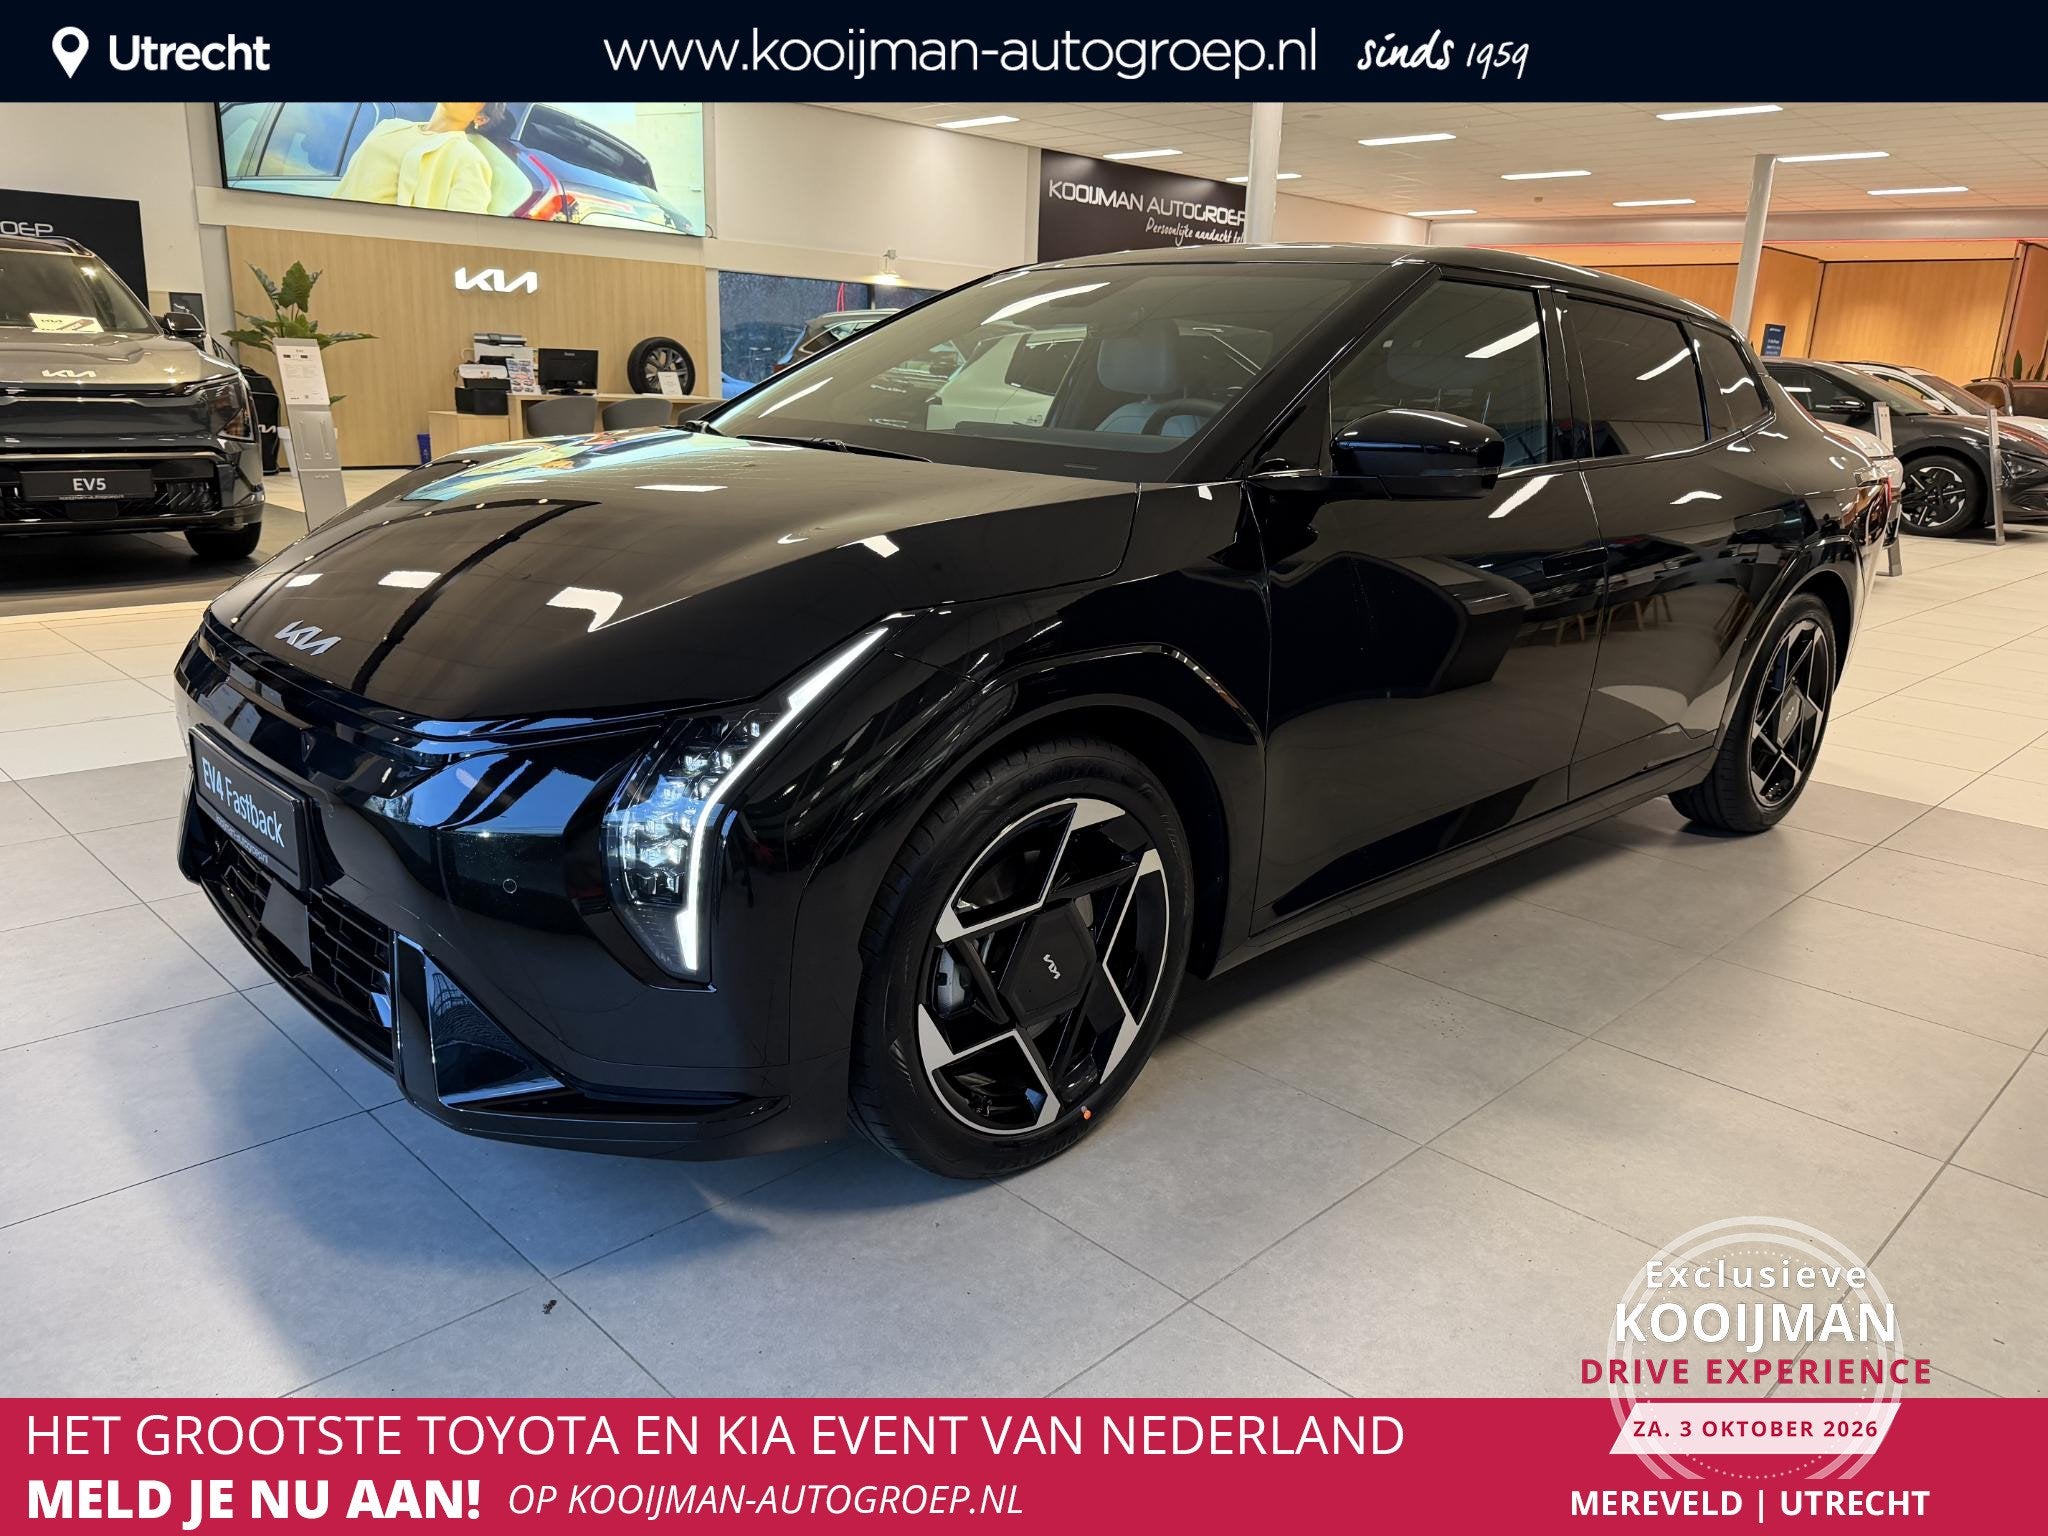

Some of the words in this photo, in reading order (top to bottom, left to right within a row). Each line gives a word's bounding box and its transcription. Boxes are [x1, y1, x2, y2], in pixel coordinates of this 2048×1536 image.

[1048, 179, 1144, 213] KOOIJMAN
[0, 221, 54, 237] OEP
[1145, 217, 1193, 247] Persoonlijke
[1195, 229, 1232, 243] aandacht
[454, 266, 538, 294] KIA
[41, 369, 97, 378] KIA
[73, 477, 107, 491] EV5
[274, 620, 342, 656] KIA
[202, 757, 224, 801] EV4
[225, 776, 285, 848] Fastback
